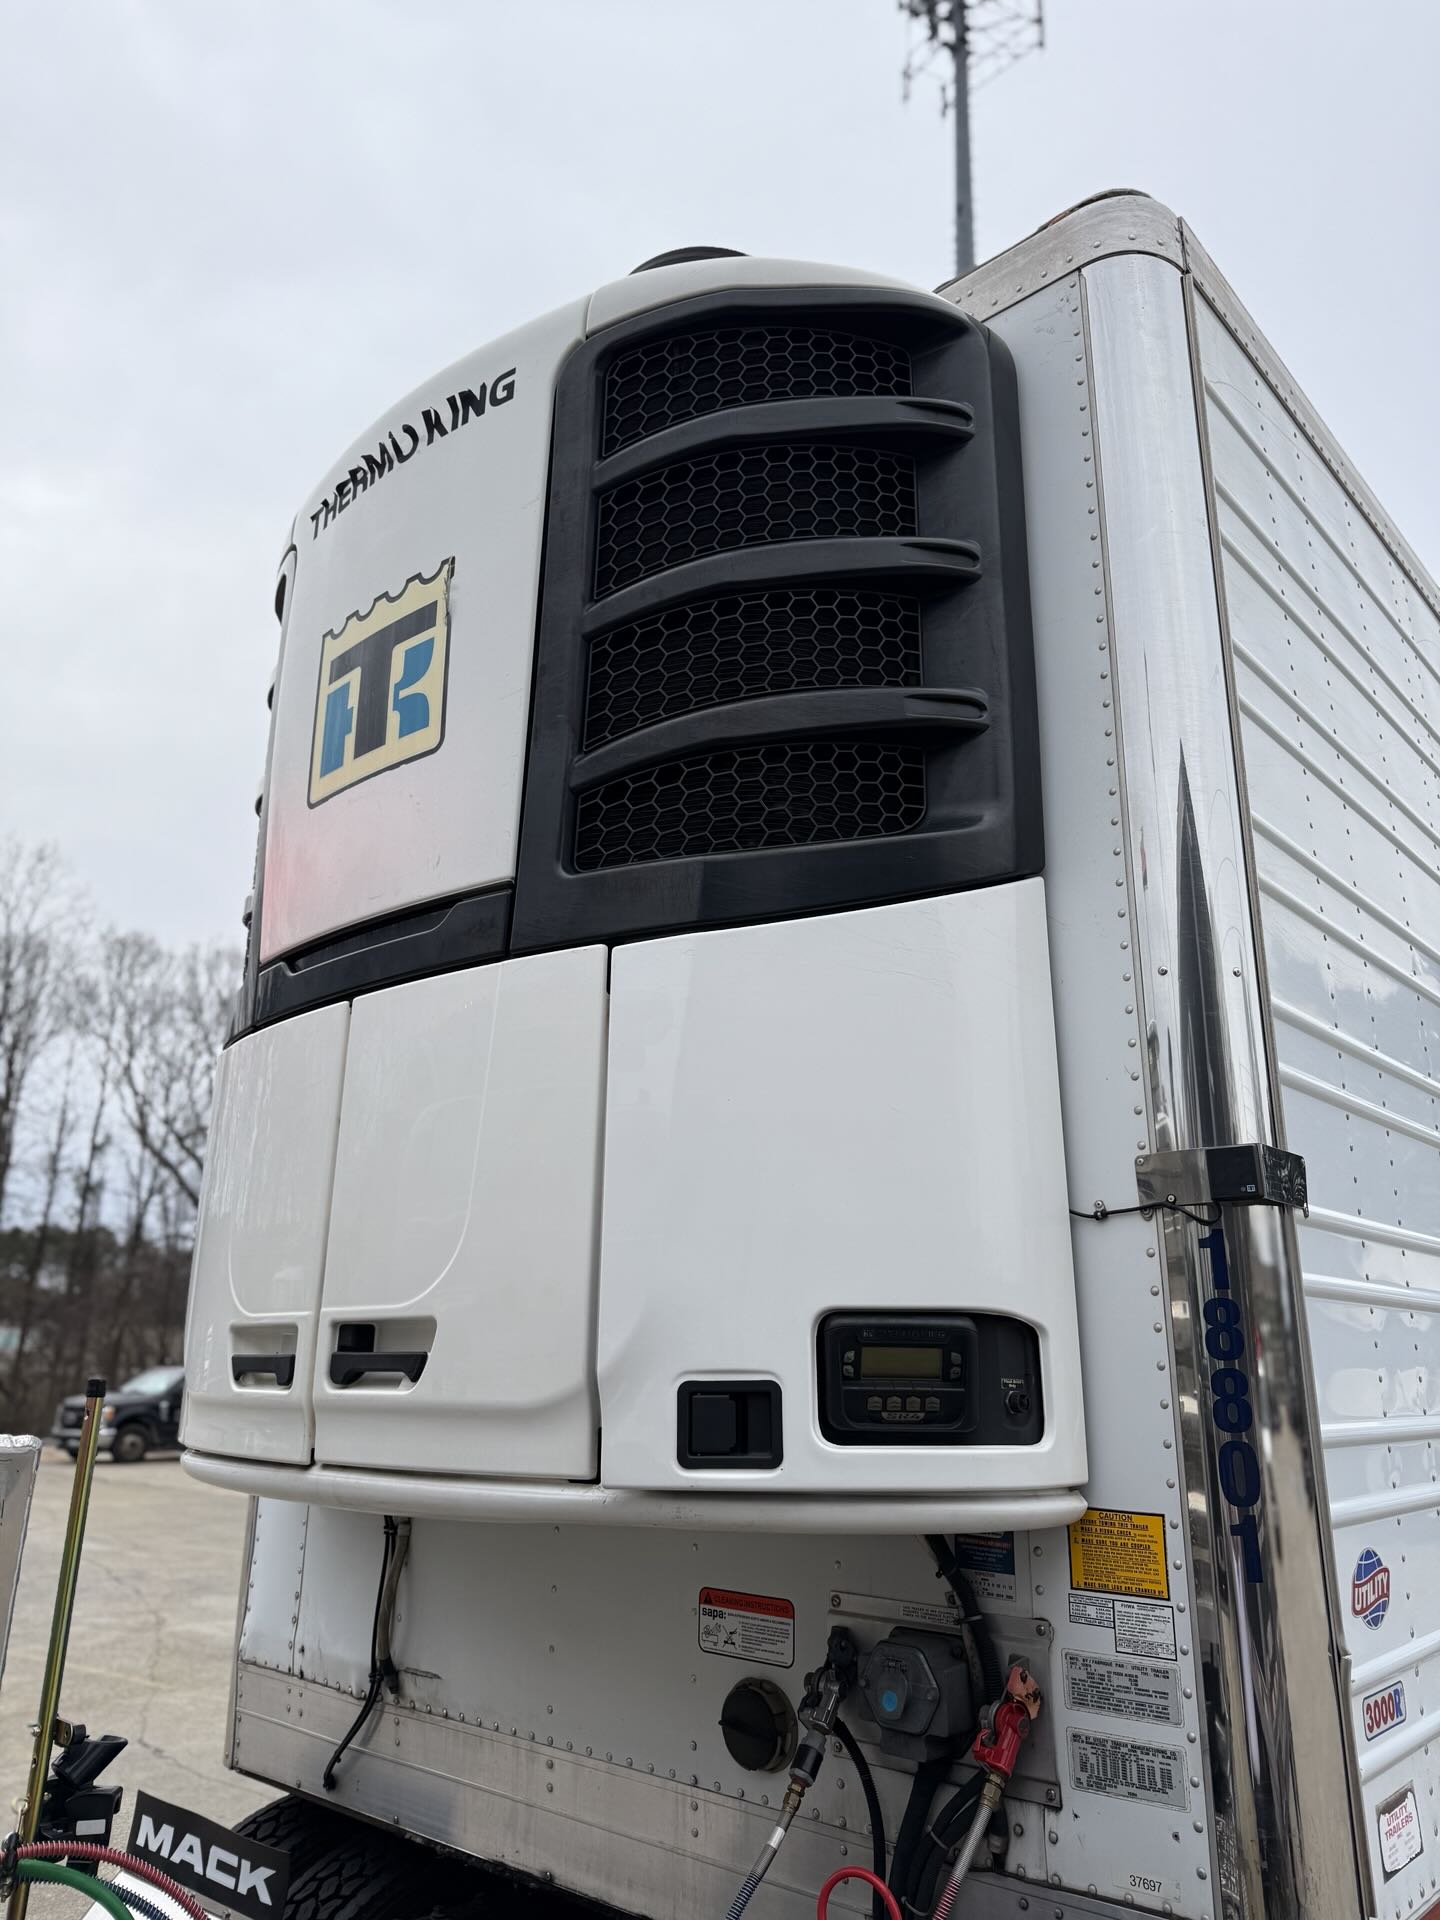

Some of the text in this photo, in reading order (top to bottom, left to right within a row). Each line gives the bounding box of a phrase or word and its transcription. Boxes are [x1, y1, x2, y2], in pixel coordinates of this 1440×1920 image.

[421, 367, 516, 447] KING
[1198, 1228, 1264, 1583] 18801
[1098, 1512, 1133, 1521] CAUTION
[1354, 1571, 1389, 1611] UTILITY
[1365, 1690, 1403, 1733] 3000R
[1131, 1744, 1168, 1754] MANUFACTURING
[1384, 1812, 1413, 1840] TRAILERS
[1386, 1803, 1408, 1826] UTILITY
[135, 1814, 276, 1906] MACK
[1130, 1874, 1162, 1892] 37697
